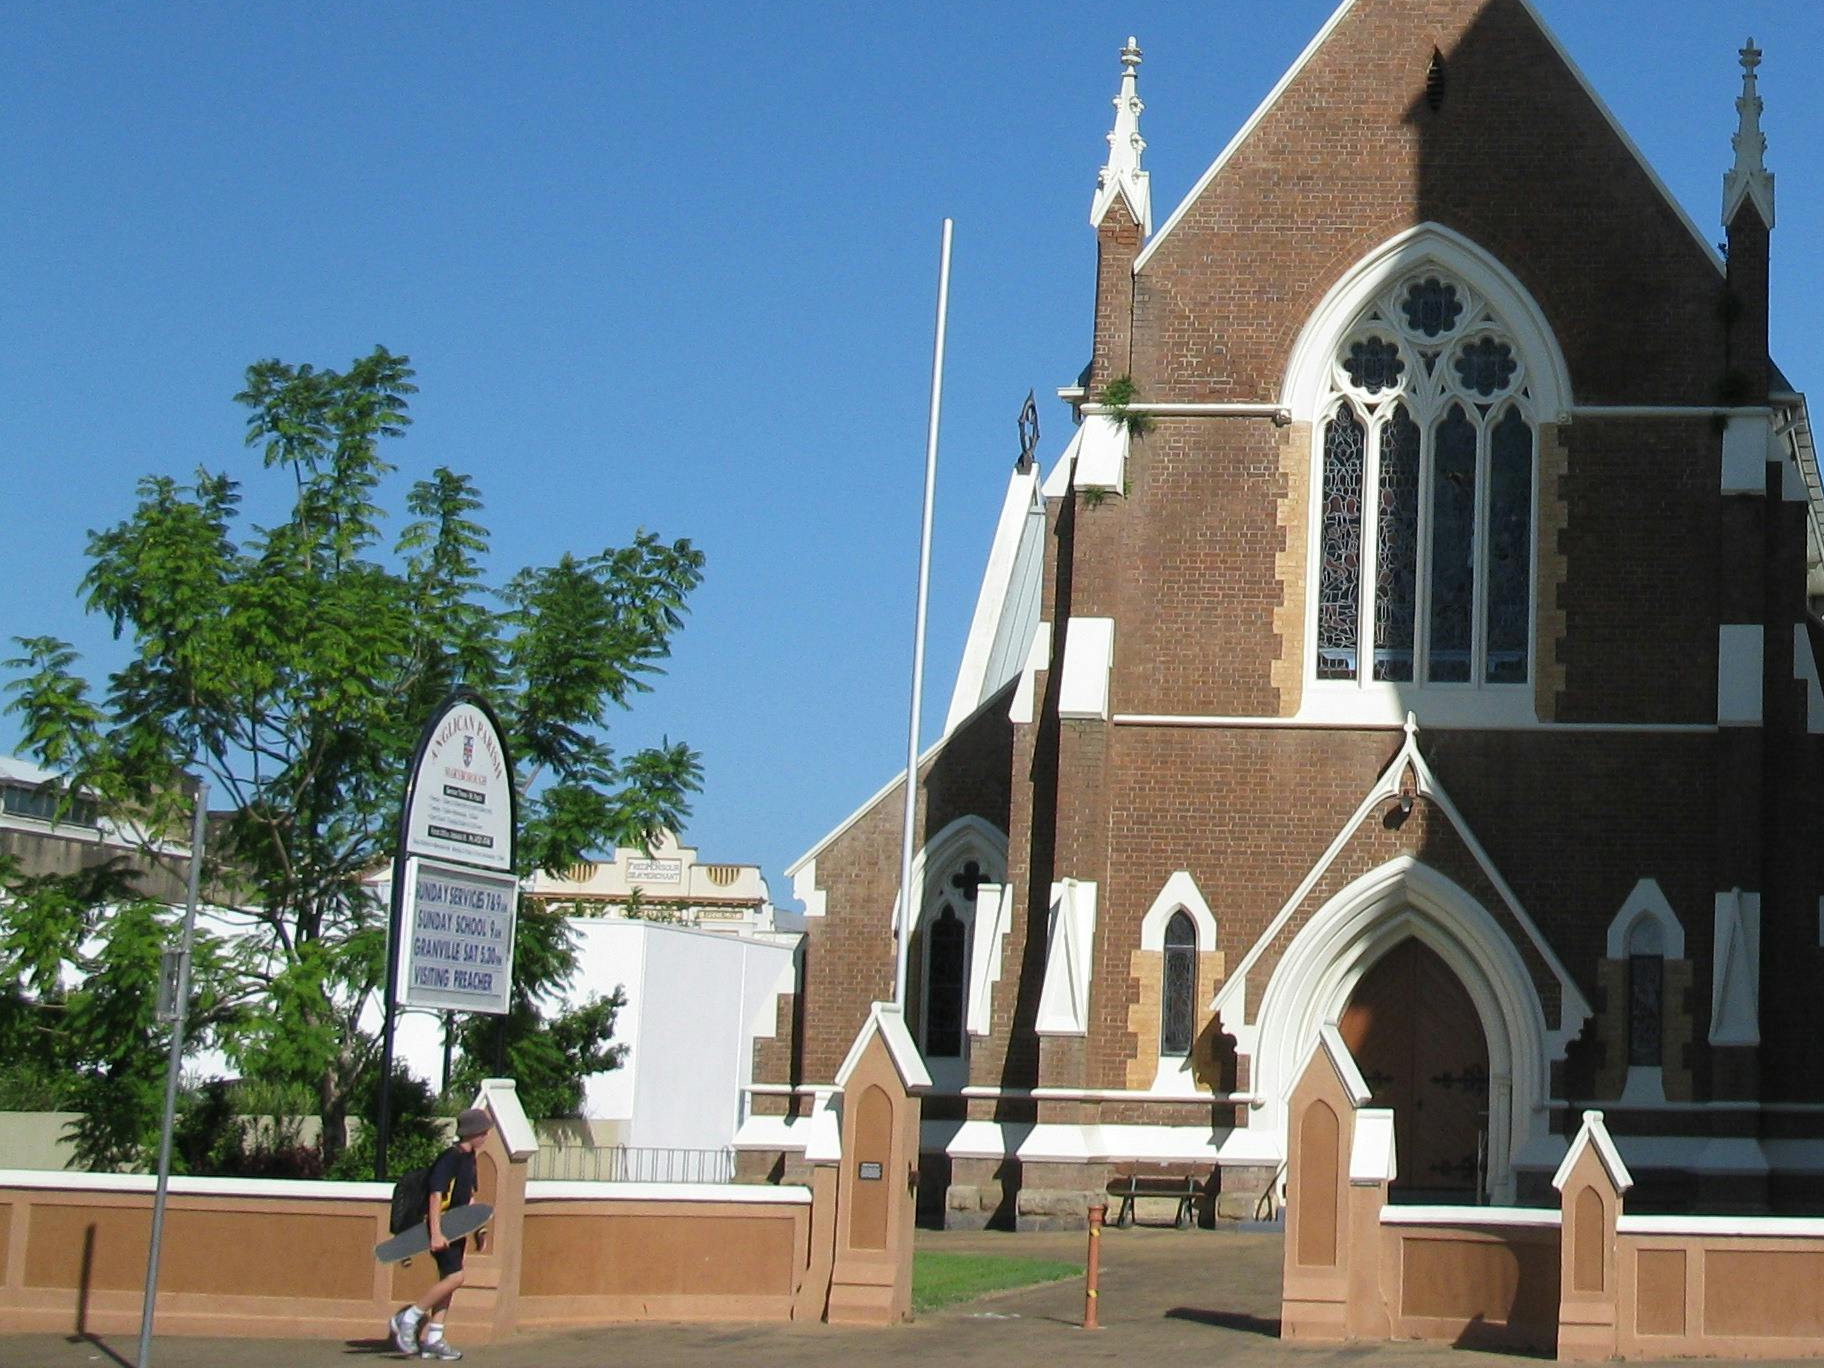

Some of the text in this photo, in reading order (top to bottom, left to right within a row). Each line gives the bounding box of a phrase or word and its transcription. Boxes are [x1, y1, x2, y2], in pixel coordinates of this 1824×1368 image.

[431, 714, 502, 780] ANGLICAN PARISH
[449, 886, 485, 907] SERVICES
[417, 909, 453, 932] SUNDAY
[455, 914, 486, 936] SCHOOL
[414, 937, 461, 961] GRANVILLE
[463, 943, 479, 963] SAT
[414, 965, 493, 991] VISITING PREACHER
